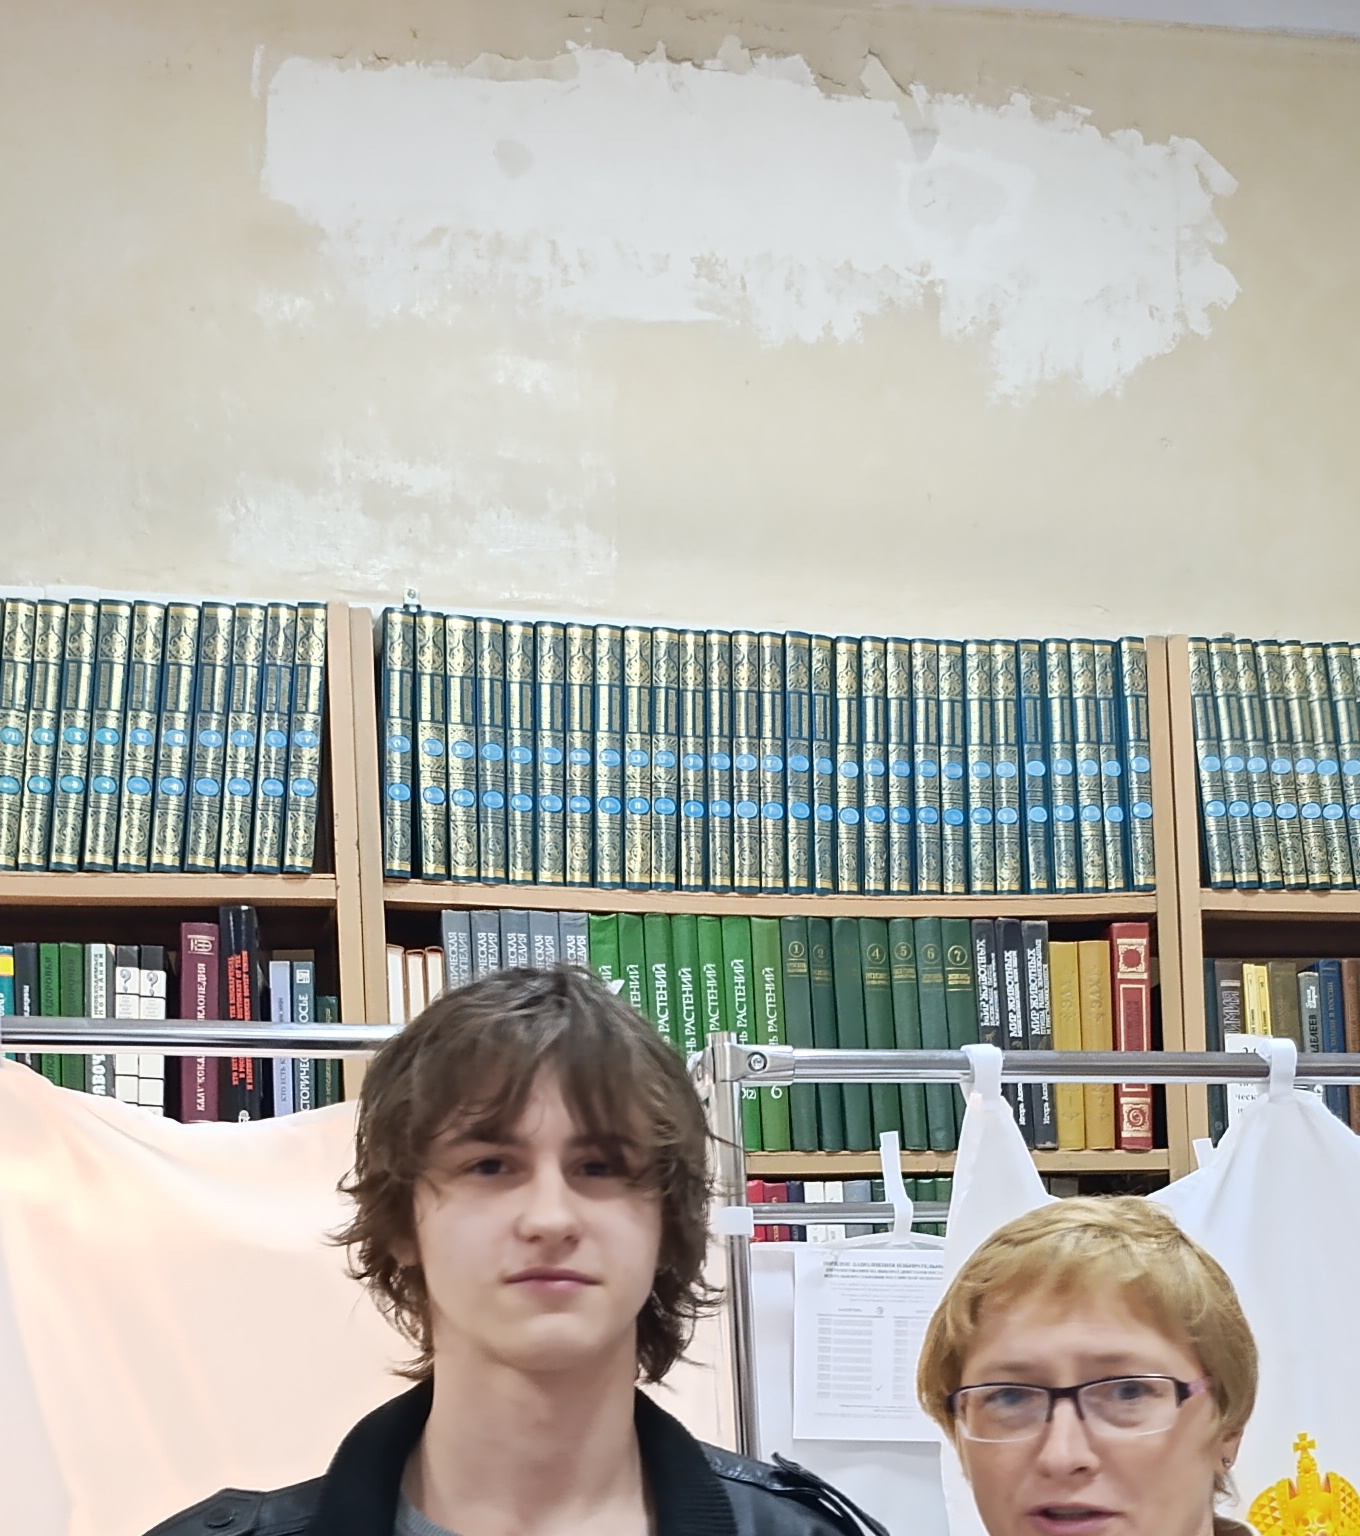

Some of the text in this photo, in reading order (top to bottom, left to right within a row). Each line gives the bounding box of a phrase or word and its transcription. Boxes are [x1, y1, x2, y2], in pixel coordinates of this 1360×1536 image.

[653, 964, 668, 1032] РАСТЕНИЙ
[679, 968, 695, 1035] РАСТЕНИЙ
[704, 964, 719, 1030] РАСТЕНИЙ
[731, 959, 746, 1027] РАСТЕНИЙ
[763, 967, 777, 1032] РАСТЕНИЙ
[976, 939, 990, 1026] МИР ЖИВОТНЫХ
[1005, 951, 1018, 1037] МИР ЖИВОТНЫХ
[1028, 948, 1040, 1034] МИР ЖИВОТНЫХ
[770, 1086, 782, 1099] 6
